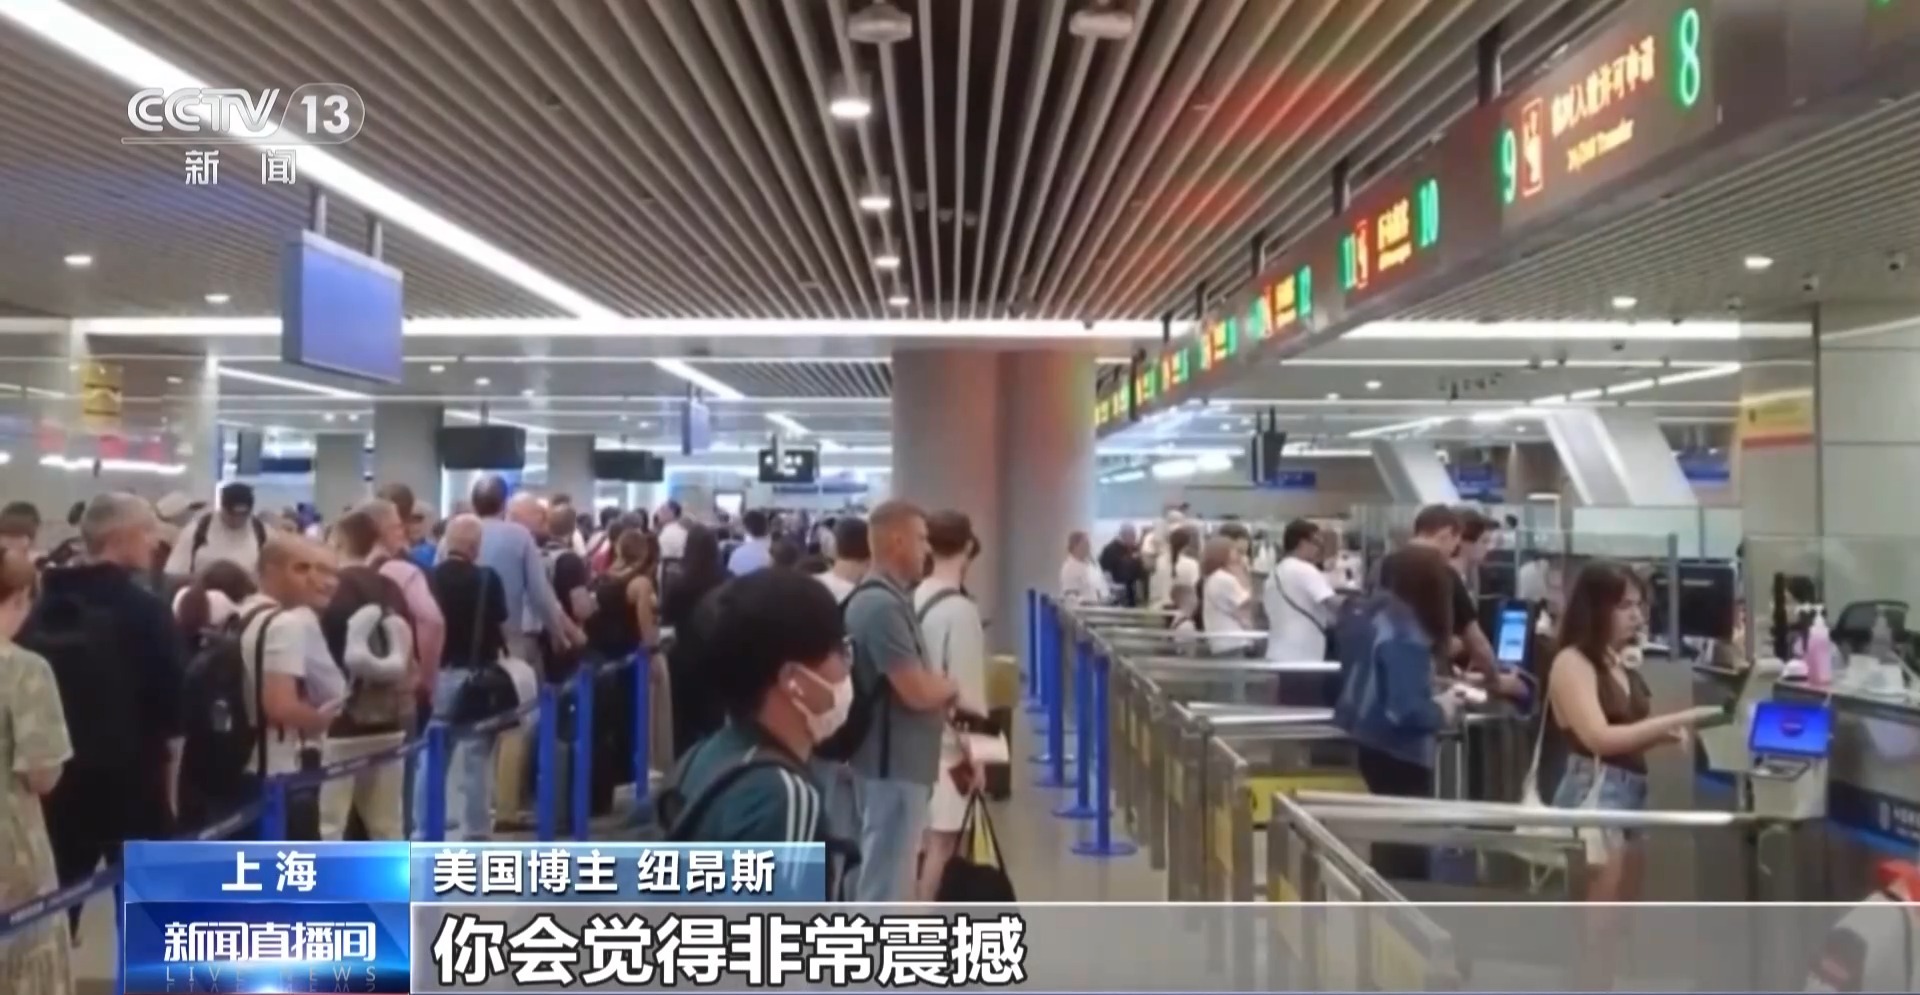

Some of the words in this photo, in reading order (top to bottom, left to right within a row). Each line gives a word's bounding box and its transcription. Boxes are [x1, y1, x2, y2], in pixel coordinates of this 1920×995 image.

[1679, 8, 1702, 107] 8
[1501, 129, 1517, 204] 9
[1418, 178, 1440, 248] 10
